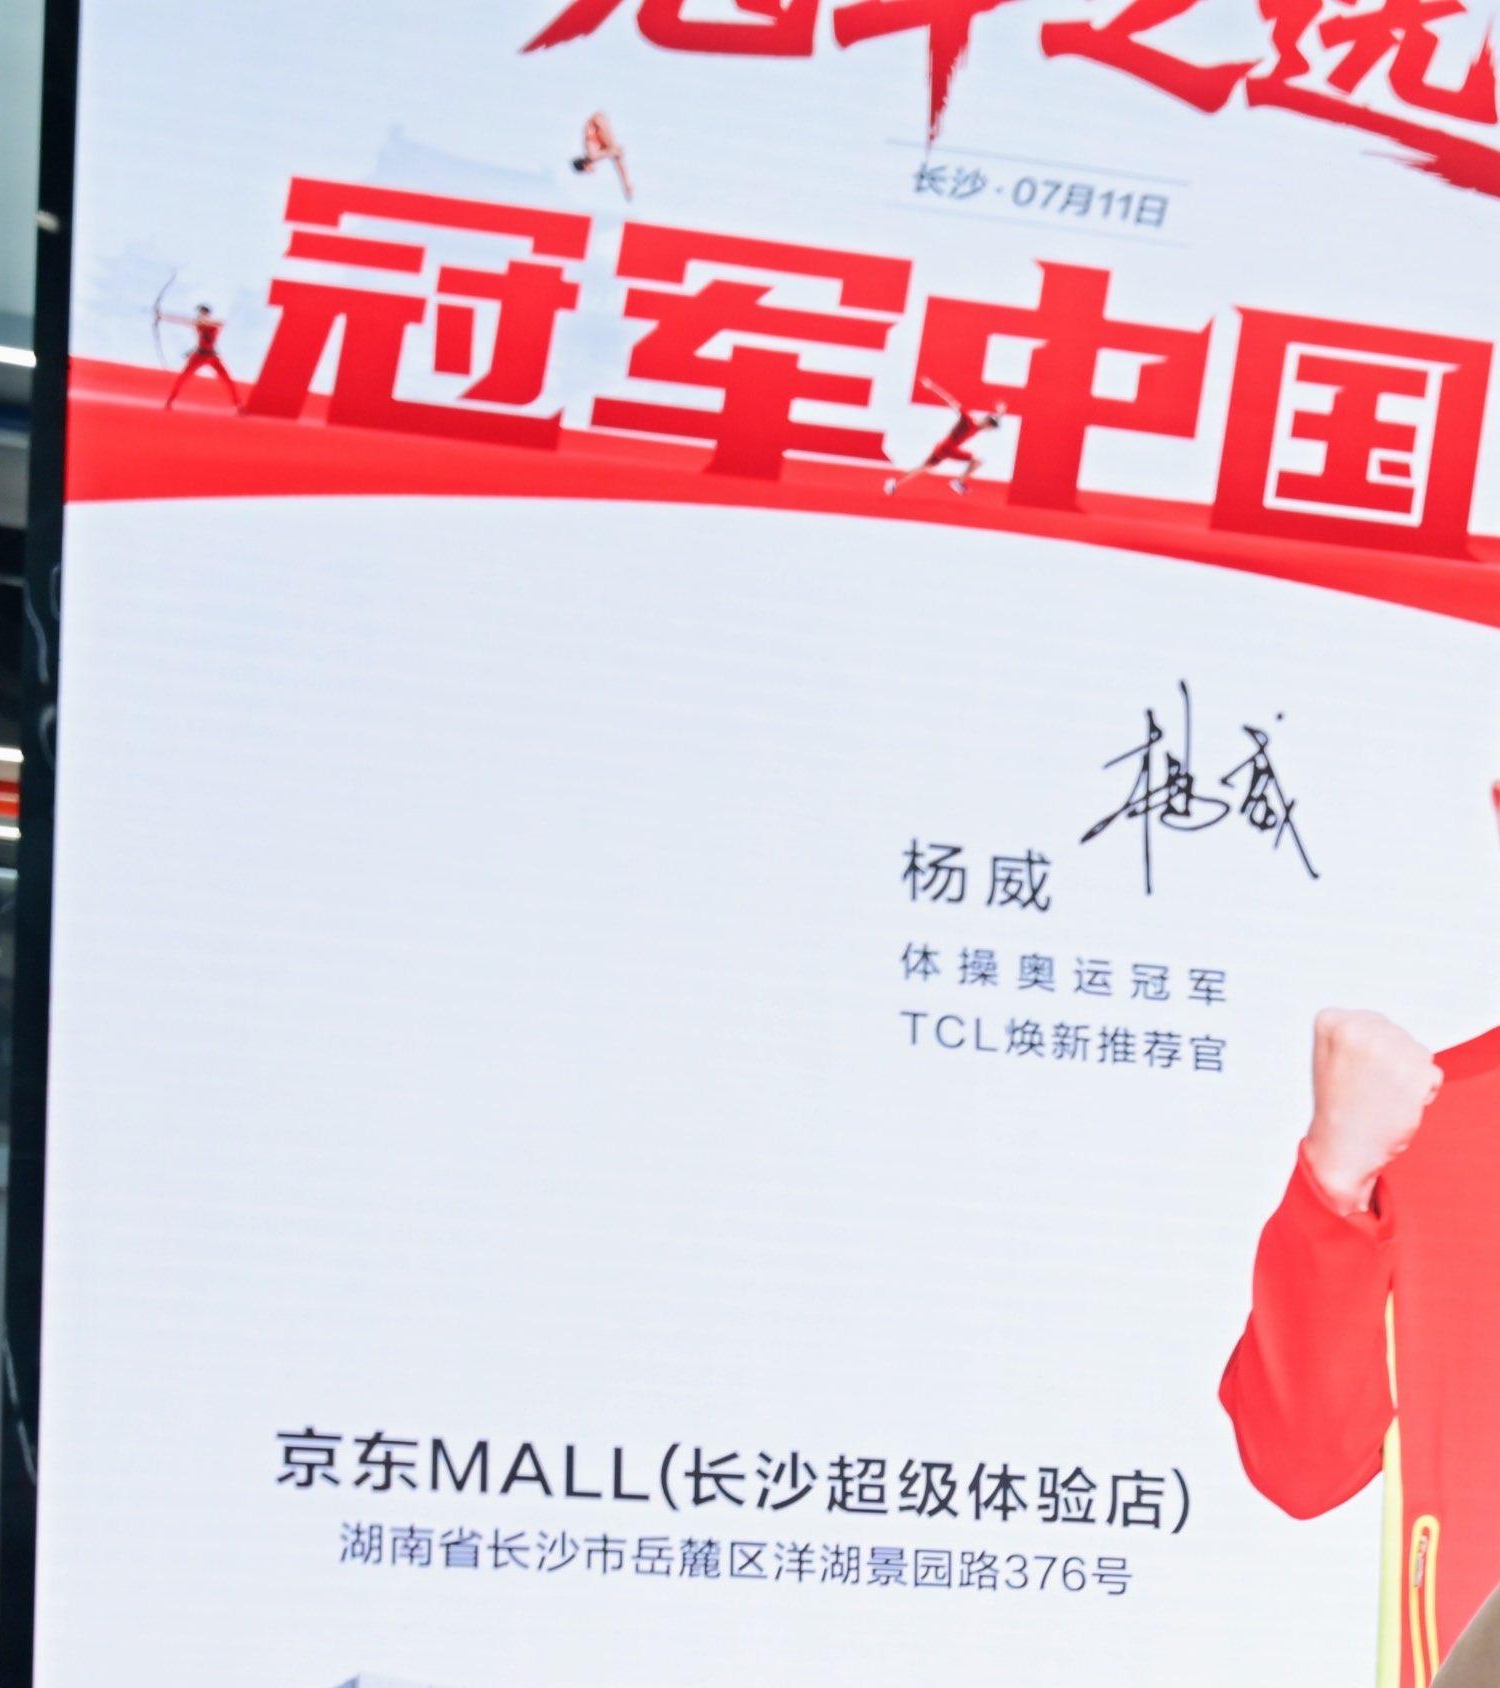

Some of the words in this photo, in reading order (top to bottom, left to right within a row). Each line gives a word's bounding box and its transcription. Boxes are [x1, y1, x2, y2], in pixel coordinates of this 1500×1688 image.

[901, 838, 1052, 912] 杨威
[900, 941, 1228, 1008] 体操奥运冠军
[899, 1010, 1228, 1073] TCL焕新推荐官
[274, 1427, 1193, 1535] 京东MALL(长沙超级体验店)
[338, 1521, 1134, 1597] 湖南省长沙市岳麓区洋湖景园路376号
